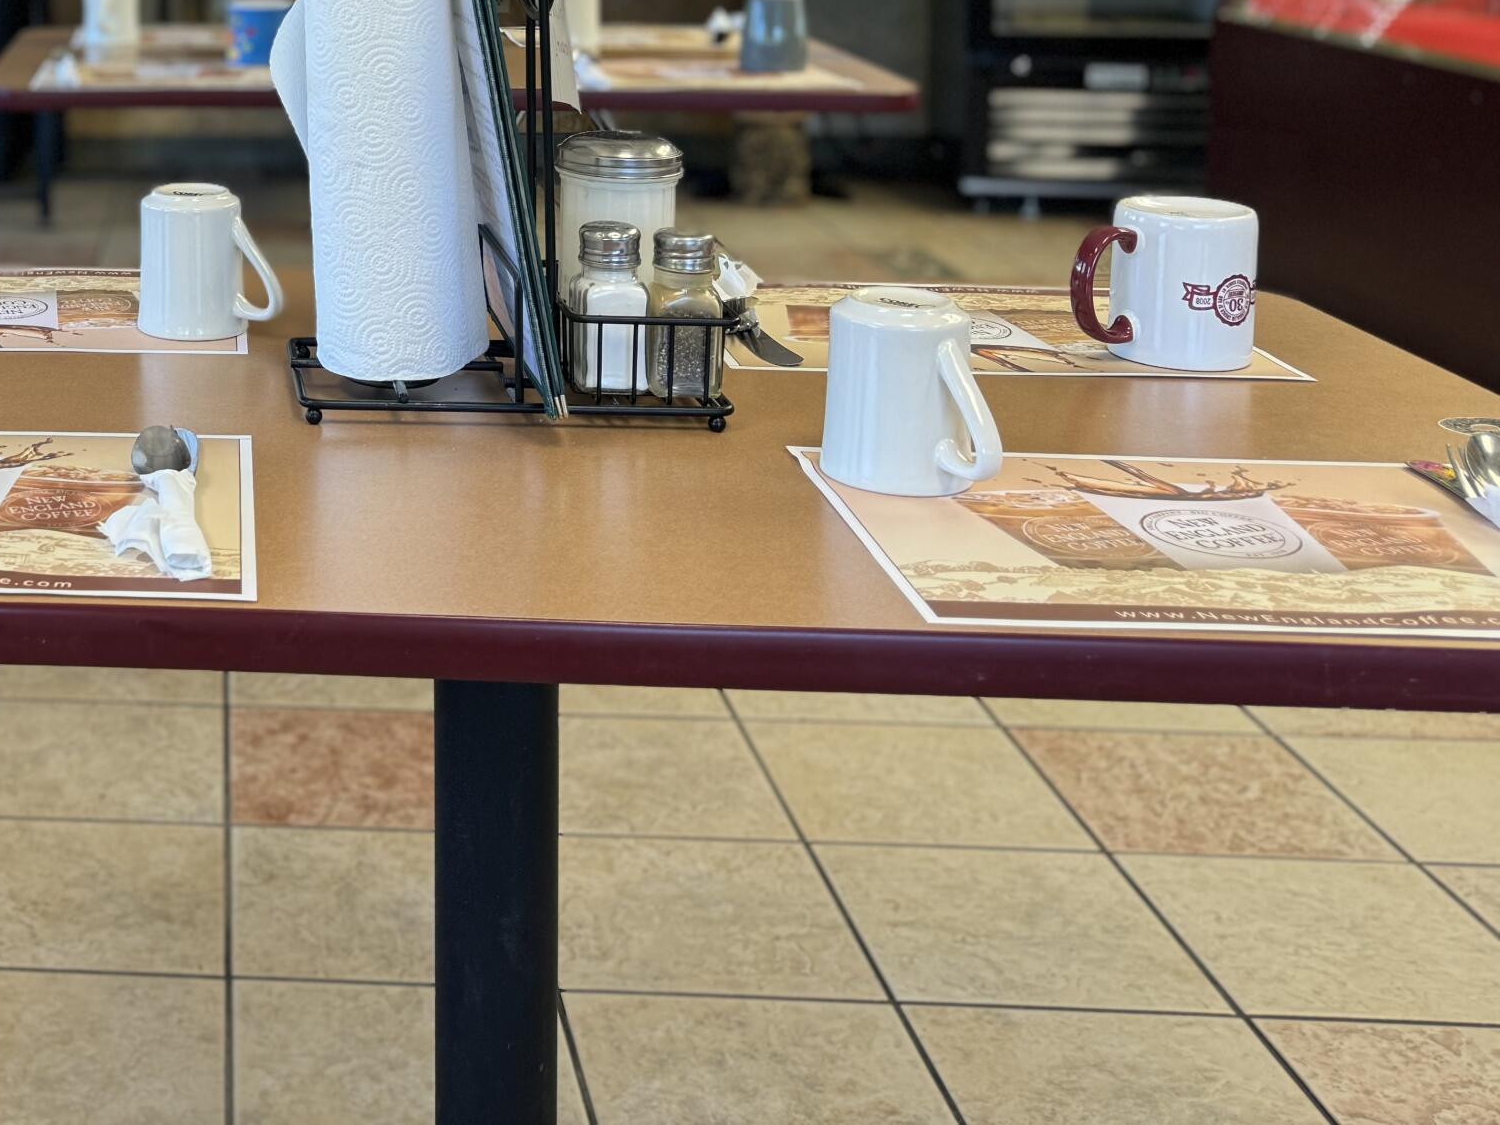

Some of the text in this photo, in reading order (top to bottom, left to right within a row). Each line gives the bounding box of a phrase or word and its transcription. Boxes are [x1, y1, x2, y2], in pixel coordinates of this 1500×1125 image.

[1195, 297, 1212, 305] 2008
[24, 495, 67, 506] NEW
[8, 501, 97, 515] ENGLAND
[20, 509, 94, 521] COFFEE
[1167, 517, 1220, 529] NEW
[1163, 523, 1268, 542] ENGLAND
[1195, 534, 1285, 550] COFFEE
